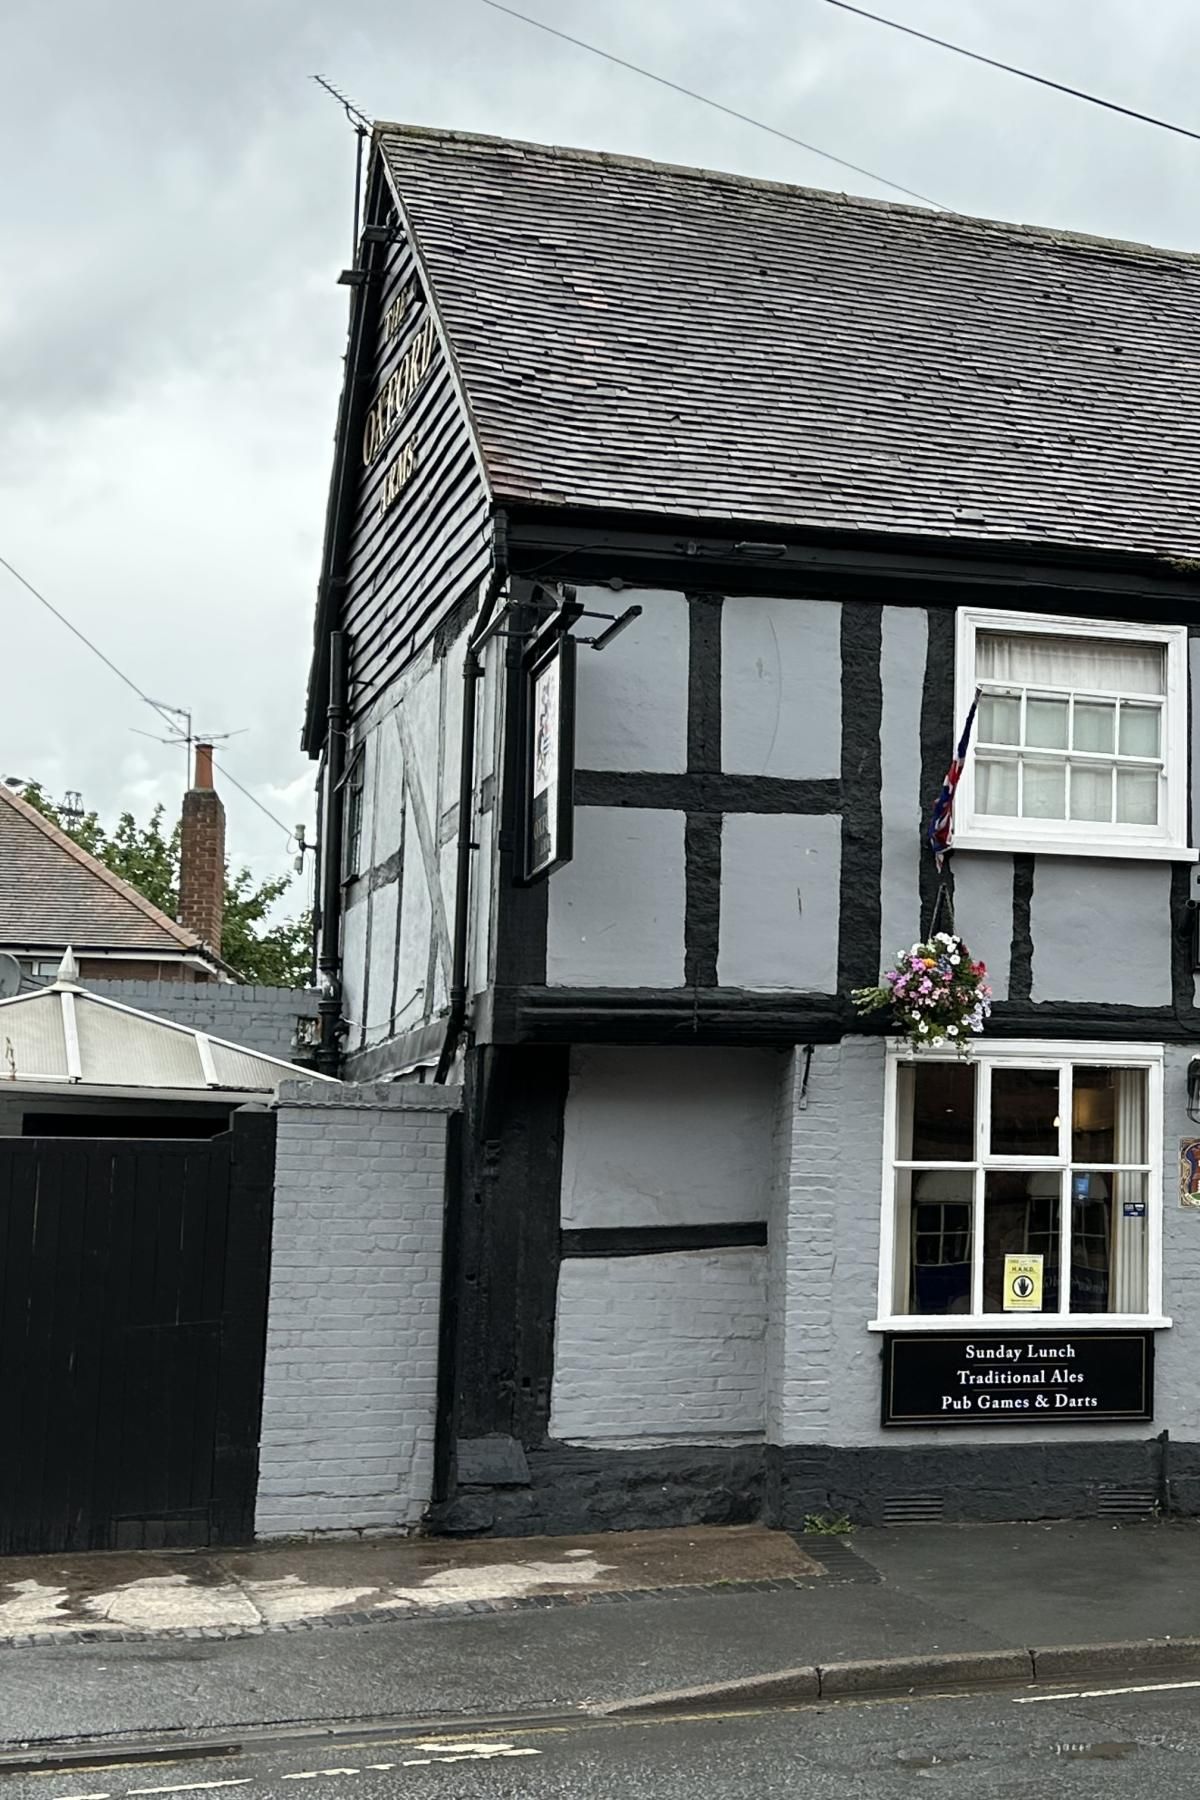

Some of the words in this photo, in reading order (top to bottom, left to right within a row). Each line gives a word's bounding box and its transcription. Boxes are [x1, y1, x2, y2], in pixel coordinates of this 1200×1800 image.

[363, 313, 435, 467] OXFORD
[965, 1345, 1022, 1361] Sunday
[1027, 1344, 1076, 1358] Lunch
[957, 1370, 1045, 1385] Traditional
[1050, 1369, 1084, 1383] Ales
[941, 1396, 972, 1410] Pub
[977, 1395, 1030, 1409] Games
[1034, 1394, 1050, 1408] &
[1055, 1394, 1098, 1407] Darts
